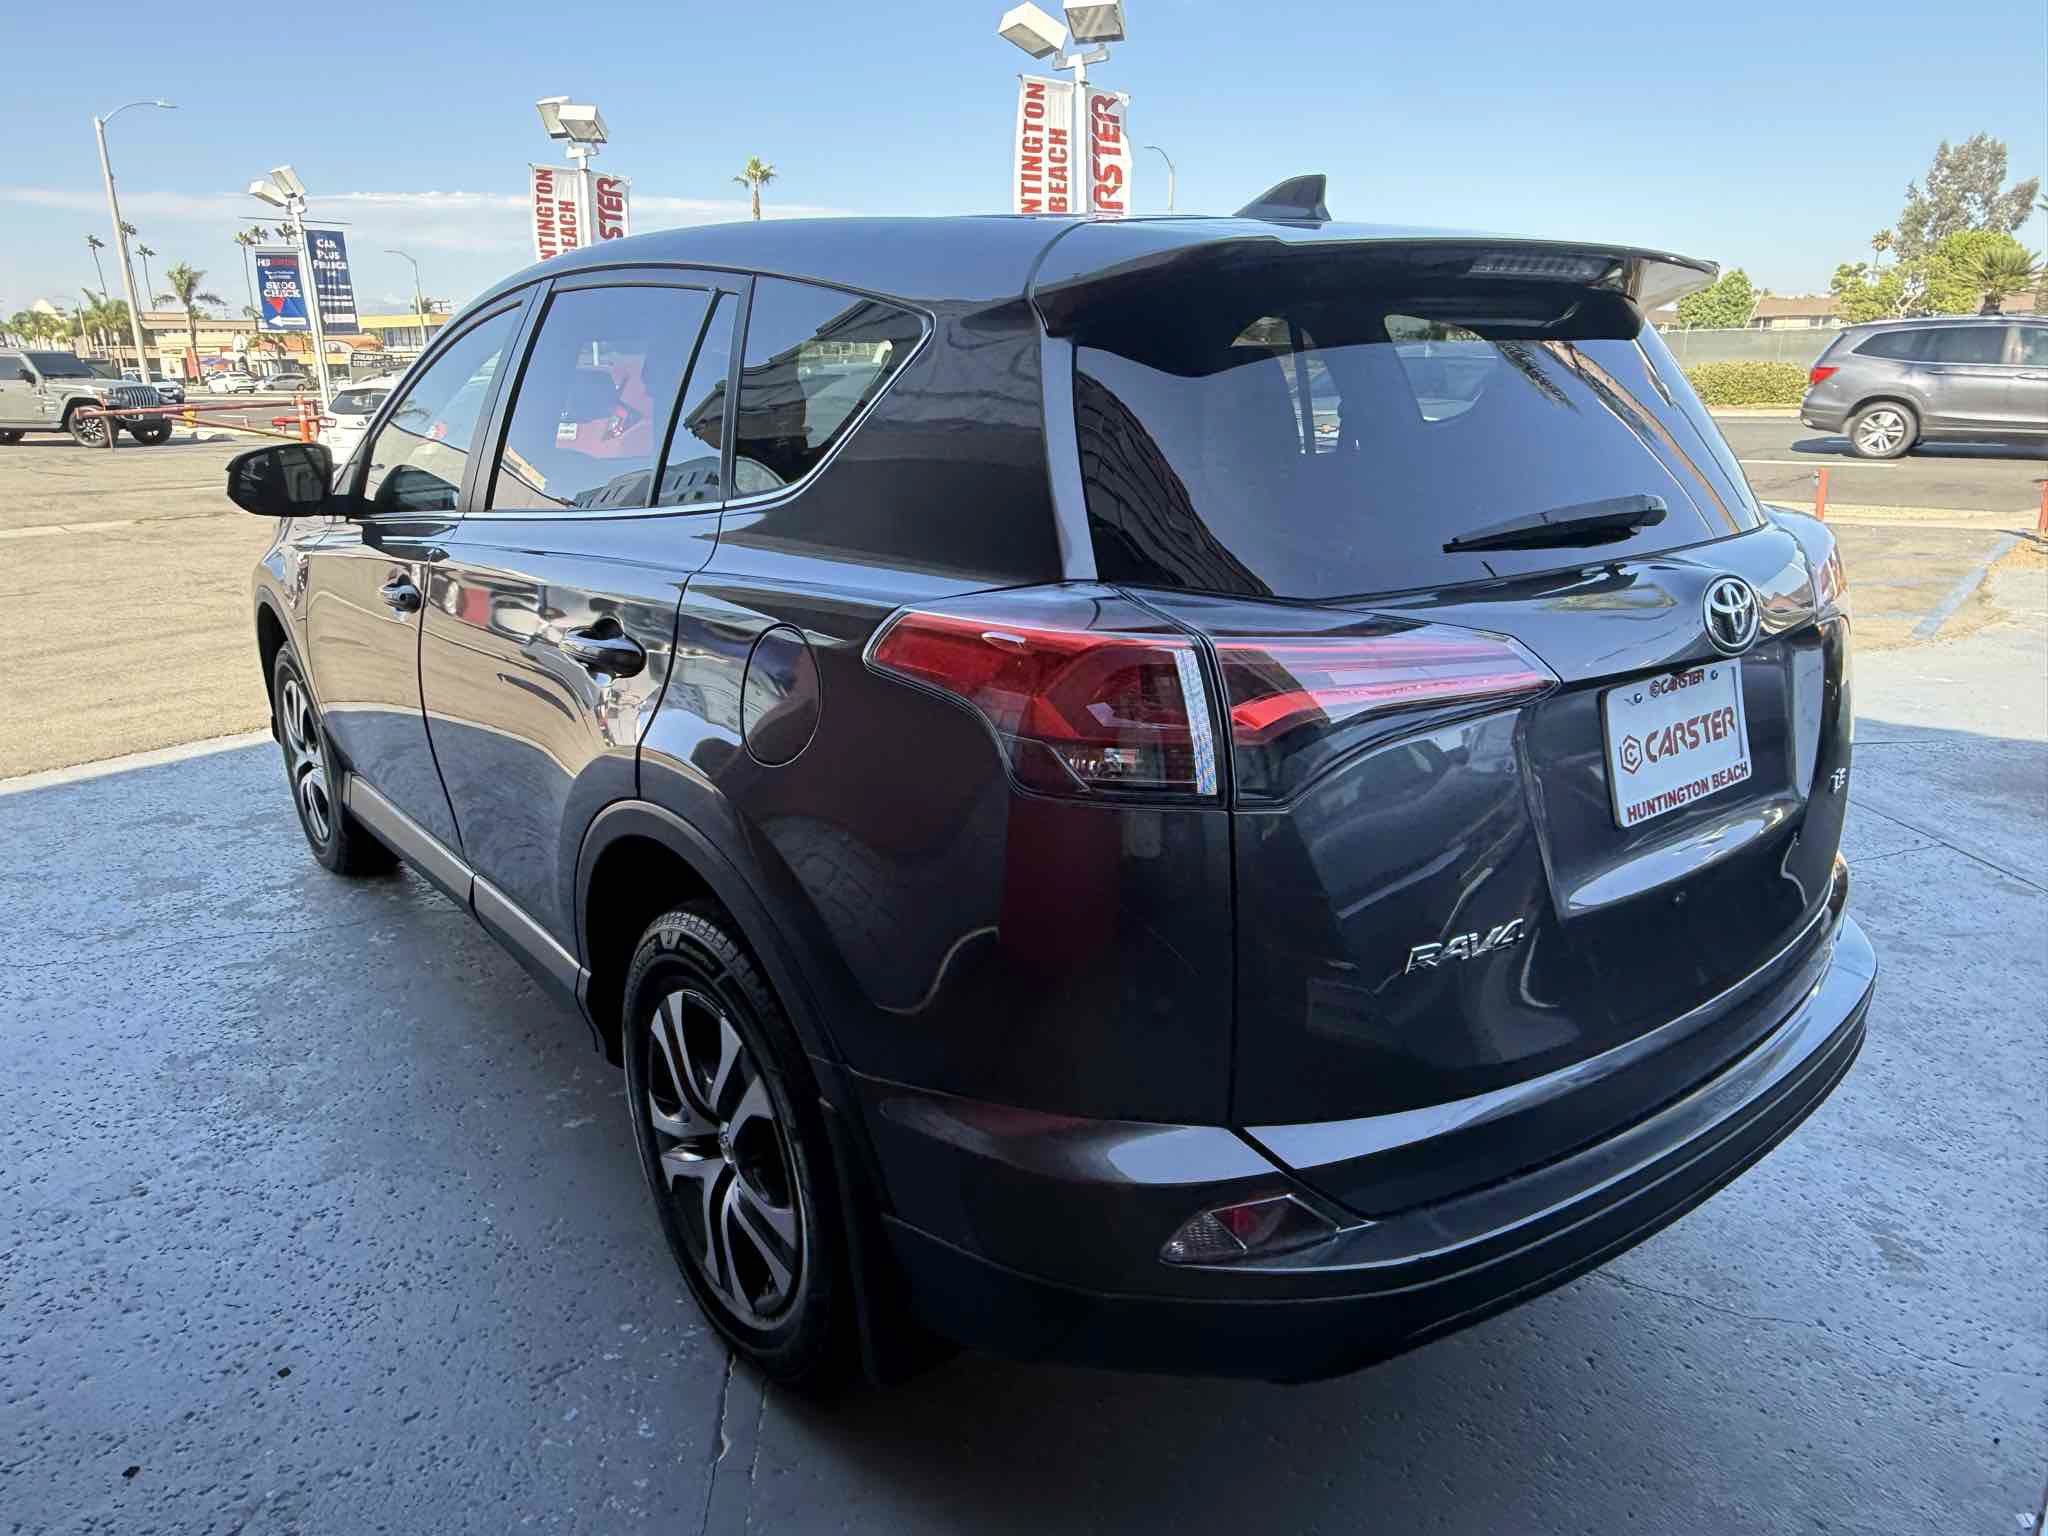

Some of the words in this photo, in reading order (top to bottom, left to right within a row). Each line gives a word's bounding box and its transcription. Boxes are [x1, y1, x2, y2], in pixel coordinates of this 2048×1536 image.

[1021, 82, 1045, 213] NTINGTON
[1048, 127, 1067, 212] BEACH
[316, 239, 337, 249] CAR
[558, 199, 578, 253] EACH
[316, 249, 341, 260] PLUS
[263, 289, 301, 298] CHECK
[264, 281, 297, 290] SMOG
[1645, 706, 1736, 763] CARSTER
[1626, 777, 1710, 824] HUNTINGTON
[1711, 761, 1750, 789] BEACH
[1404, 917, 1525, 976] RAV4
